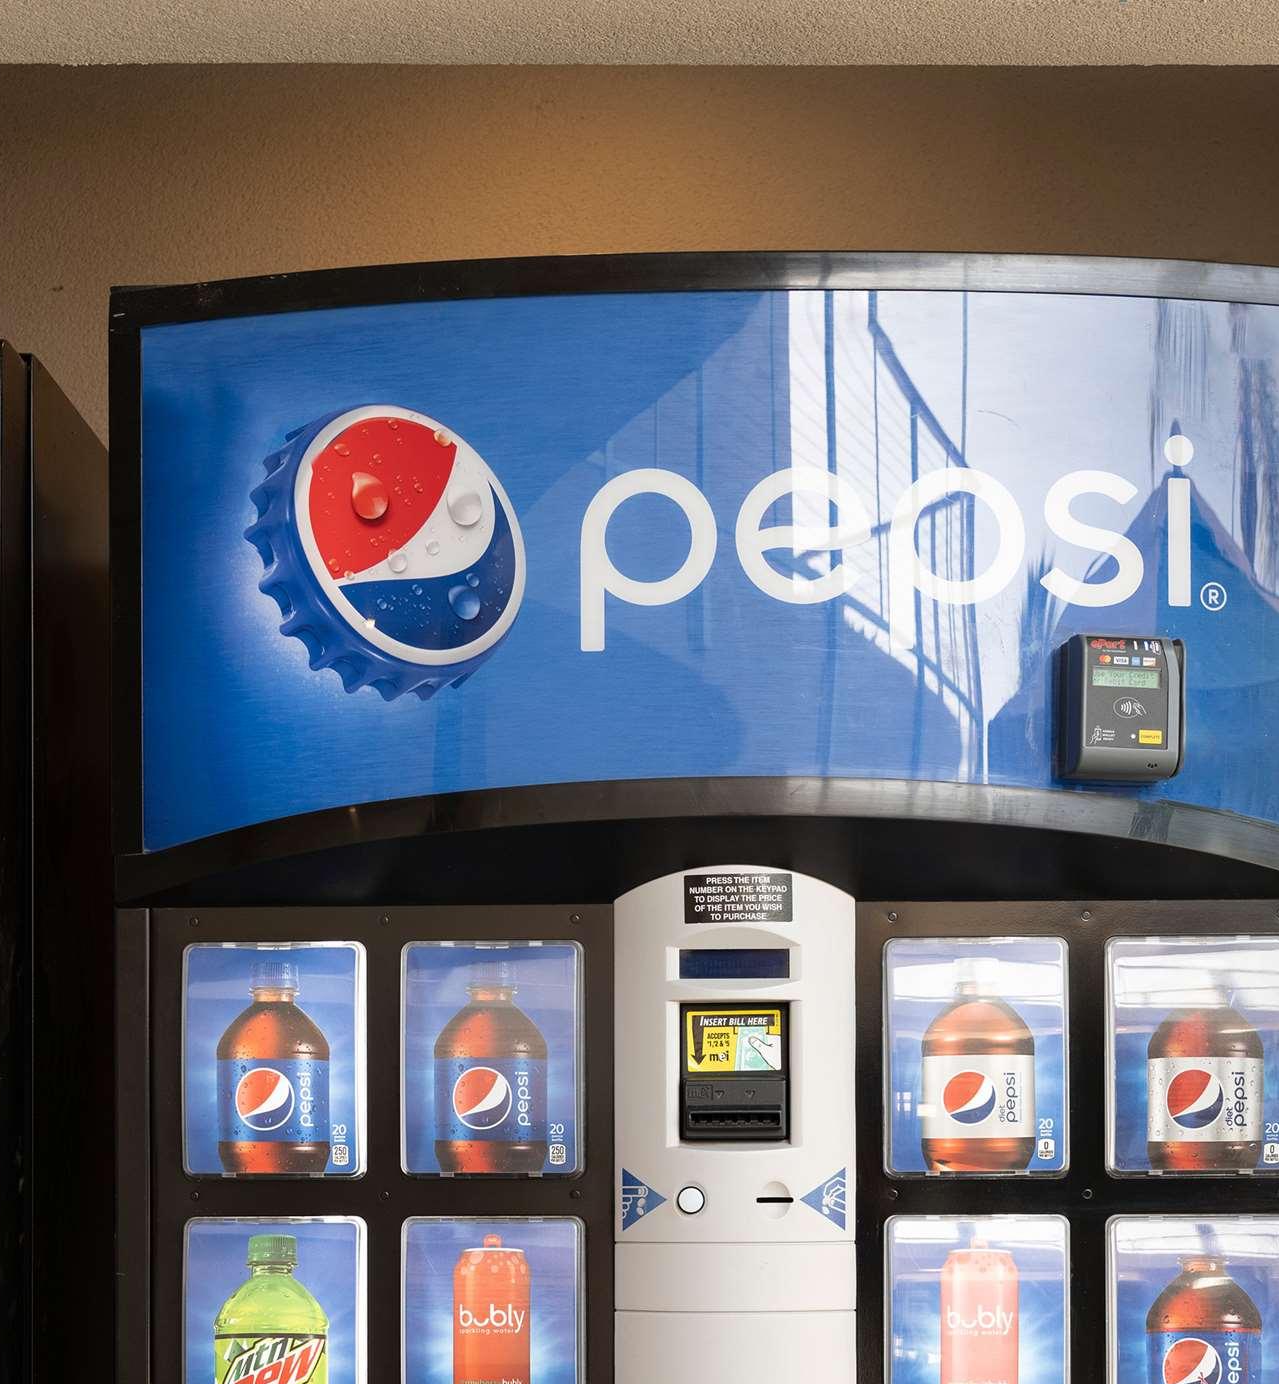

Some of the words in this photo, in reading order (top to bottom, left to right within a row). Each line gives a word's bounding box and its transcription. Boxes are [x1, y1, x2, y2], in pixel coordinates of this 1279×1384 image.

[580, 434, 1194, 652] pepsi
[706, 877, 733, 885] PRESS
[733, 876, 750, 884] THE
[752, 876, 771, 884] ITEM
[689, 886, 724, 894] NUMBER
[725, 885, 737, 893] ON
[739, 885, 754, 893] THE
[756, 885, 788, 893] KEYPAD
[694, 895, 705, 903] TO
[707, 895, 740, 903] DISPLAY
[741, 894, 757, 902] THE
[759, 894, 783, 902] PRICE
[694, 904, 706, 912] OF
[707, 904, 722, 912] THE
[744, 903, 761, 911] YOU
[762, 903, 783, 911] WISH
[710, 913, 721, 921] TO
[723, 912, 768, 920] PURCHASE
[700, 1016, 728, 1026] INSERT
[729, 1017, 745, 1026] BILL
[747, 1017, 768, 1025] HERE
[299, 1071, 314, 1128] pepsi
[515, 1071, 531, 1126] pepsi
[1004, 1071, 1019, 1123] pepsi
[1231, 1071, 1247, 1127] pepsi
[549, 1123, 564, 1135] 20
[1039, 1118, 1054, 1129] 20
[1265, 1122, 1279, 1134] 20
[332, 1124, 347, 1135] 20
[334, 1146, 347, 1156] 250
[551, 1145, 565, 1155] 250
[1044, 1141, 1049, 1150] 0
[1270, 1144, 1274, 1154] 0
[459, 1303, 526, 1334] bubly
[947, 1304, 1014, 1335] bubly
